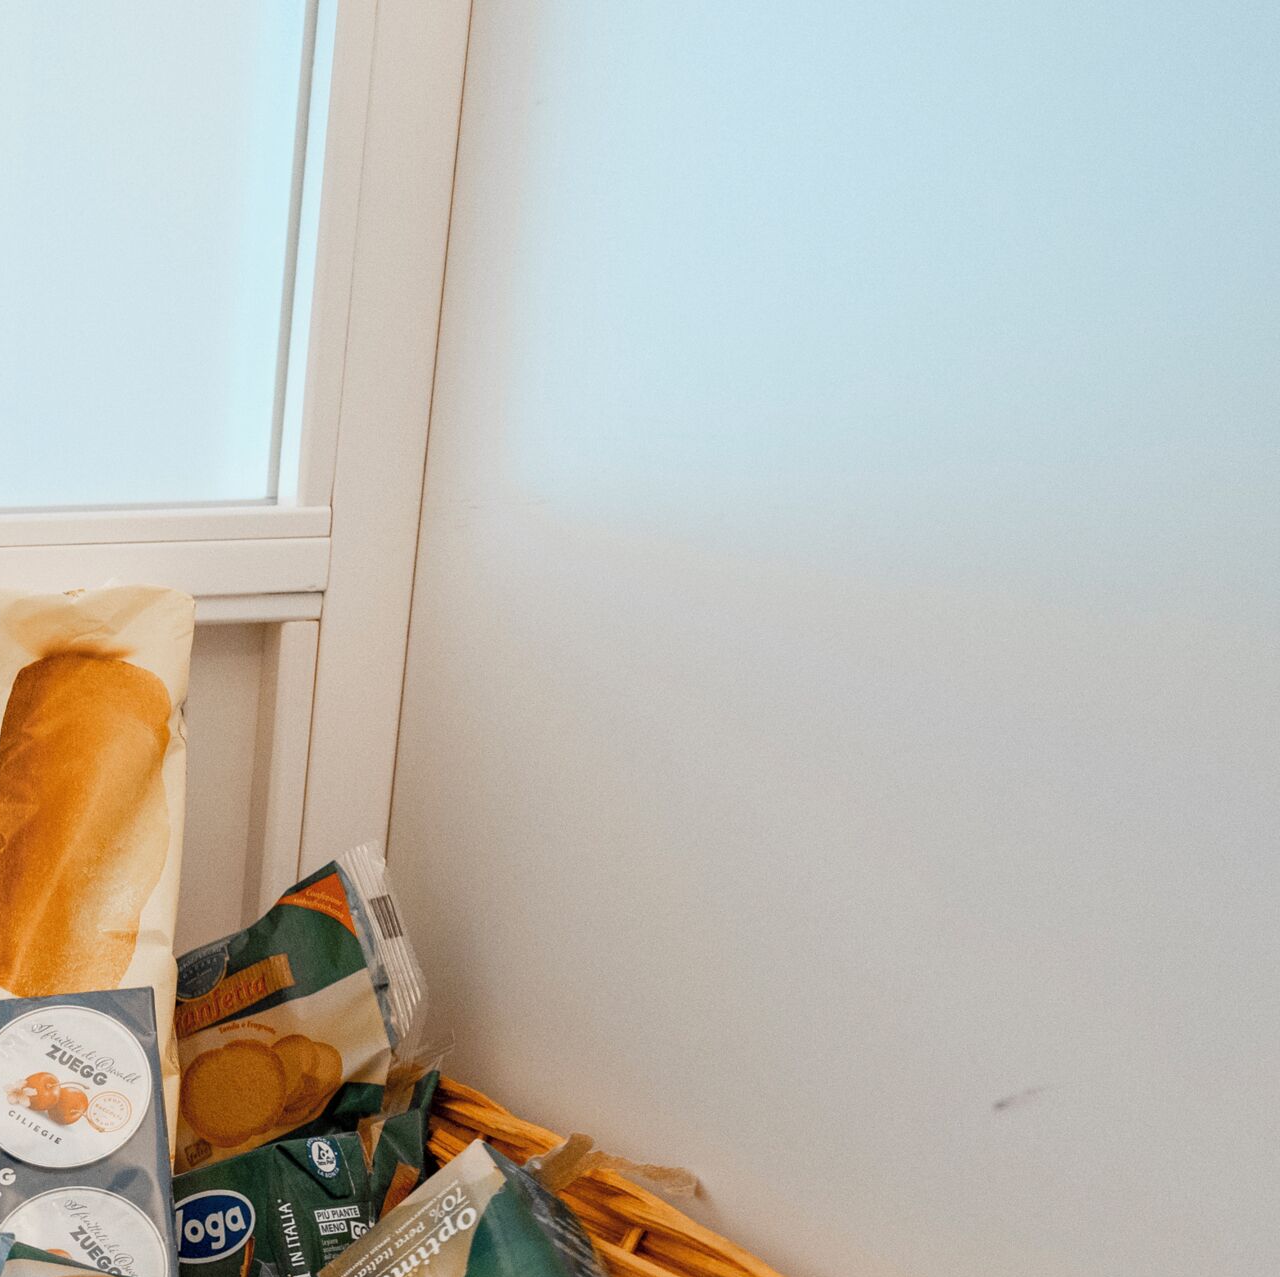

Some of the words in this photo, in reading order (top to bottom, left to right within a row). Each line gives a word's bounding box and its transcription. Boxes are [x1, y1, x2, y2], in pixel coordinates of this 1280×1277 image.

[45, 1044, 108, 1086] ZUEGG
[8, 1110, 62, 1144] CILIEGIE
[331, 1207, 359, 1219] PIANTE
[429, 1187, 467, 1223] 70%
[279, 1201, 301, 1248] ITALIA
[320, 1221, 346, 1233] MENO
[290, 1253, 306, 1267] IN
